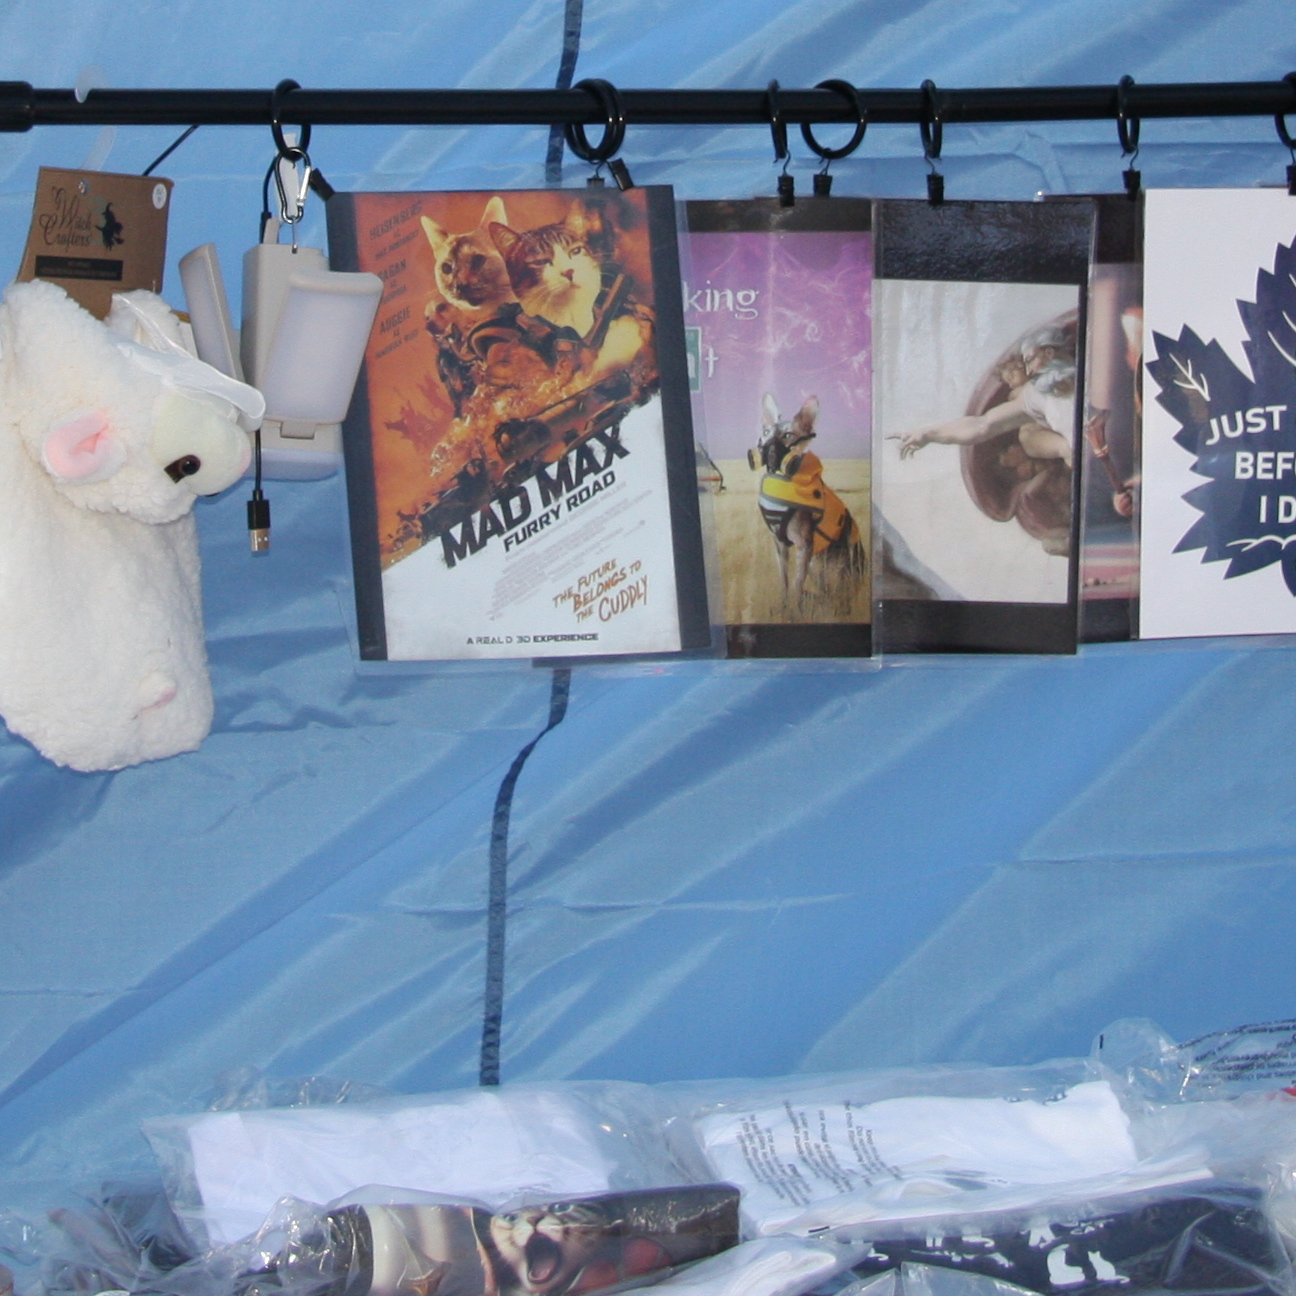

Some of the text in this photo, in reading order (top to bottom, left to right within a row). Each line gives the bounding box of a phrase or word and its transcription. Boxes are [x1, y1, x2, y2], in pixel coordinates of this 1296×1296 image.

[1205, 406, 1288, 446] JUST
[440, 482, 532, 569] MAD
[535, 424, 631, 509] MAX
[504, 505, 562, 552] FURRY
[565, 470, 616, 512] ROAD
[1259, 495, 1267, 523] I
[552, 558, 616, 608] THE FUTURE
[572, 560, 642, 613] BELONGS TO
[576, 575, 648, 623] THE CUDDLY
[467, 637, 474, 645] A
[533, 633, 599, 643] EXPERIENCE
